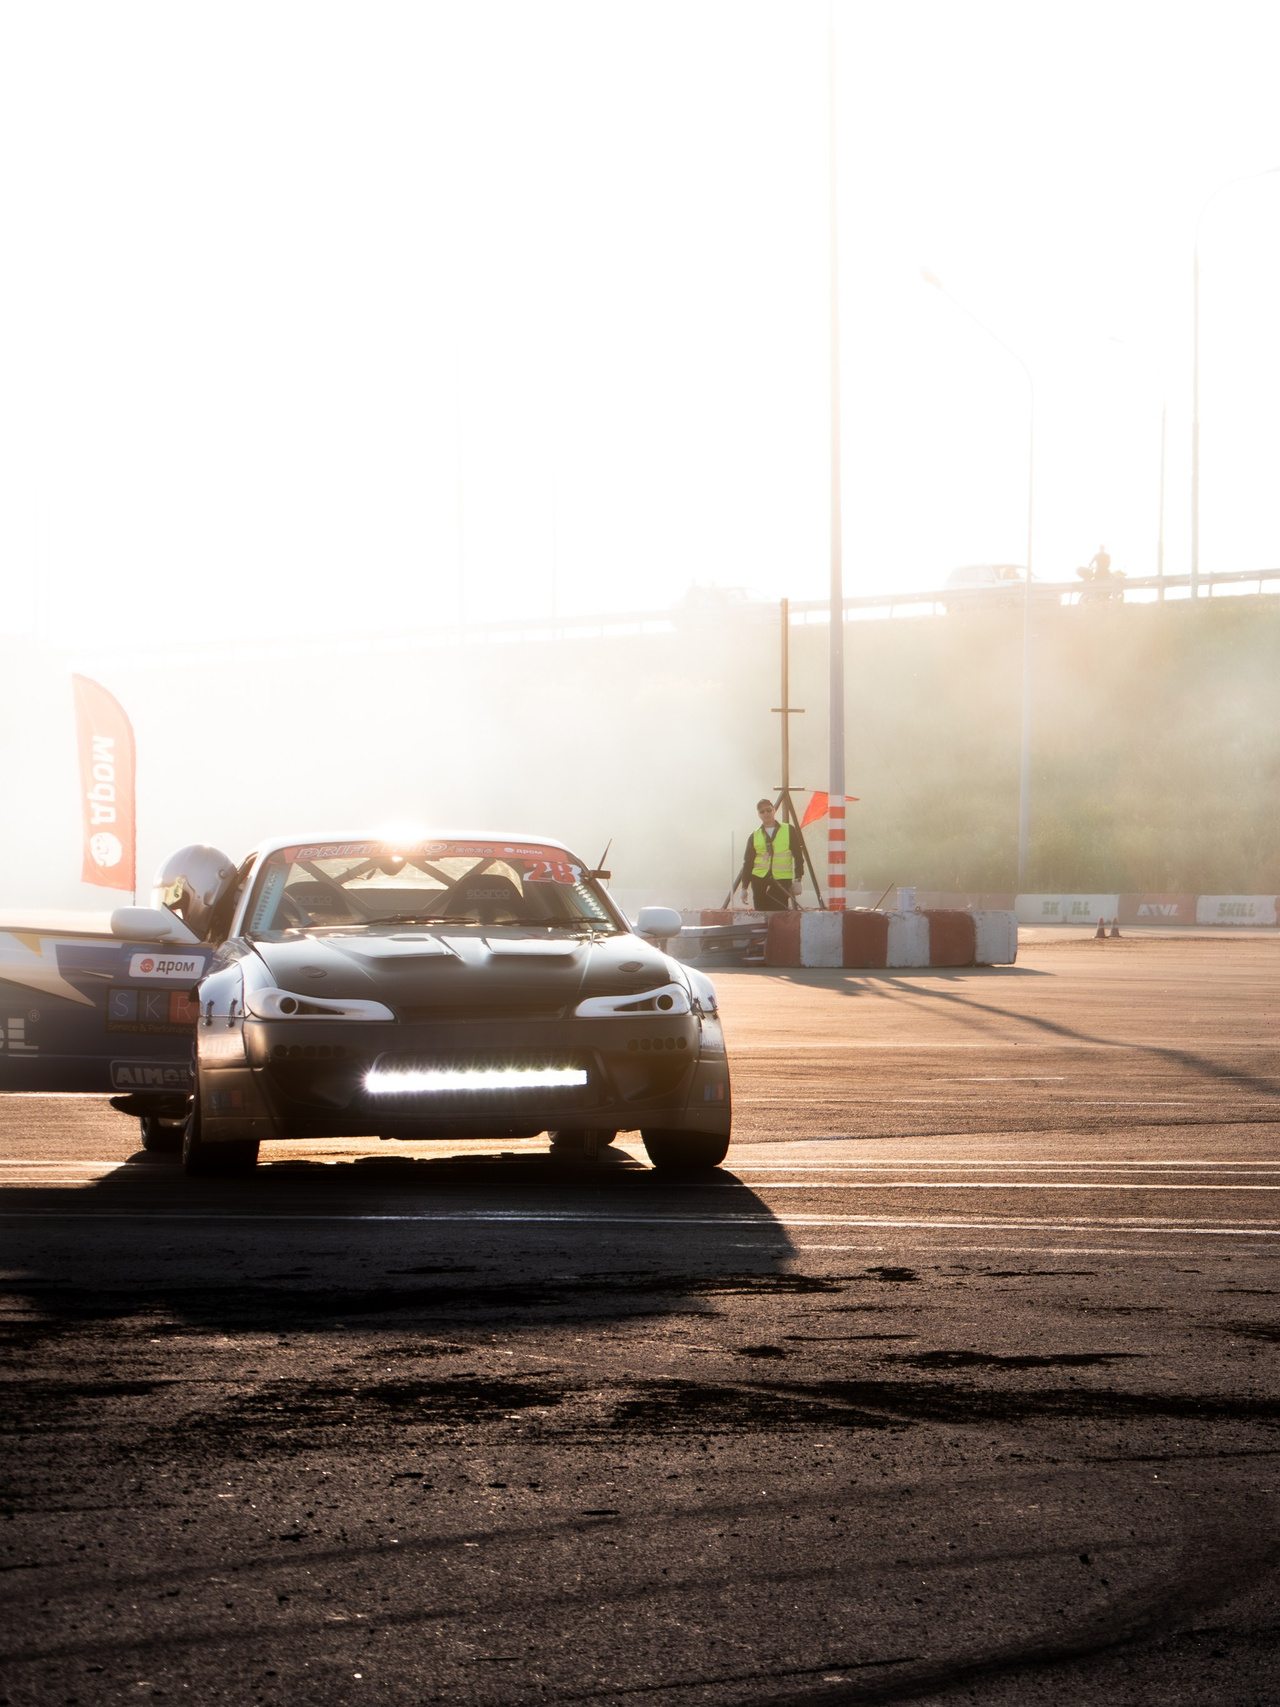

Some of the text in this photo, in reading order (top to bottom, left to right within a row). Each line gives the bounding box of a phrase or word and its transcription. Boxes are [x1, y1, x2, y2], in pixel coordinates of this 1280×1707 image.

[296, 844, 371, 860] DRIFT
[523, 860, 582, 885] 28
[295, 895, 333, 906] parco
[1217, 902, 1256, 918] SKILL
[156, 961, 195, 975] дром
[114, 993, 191, 1020] SKR
